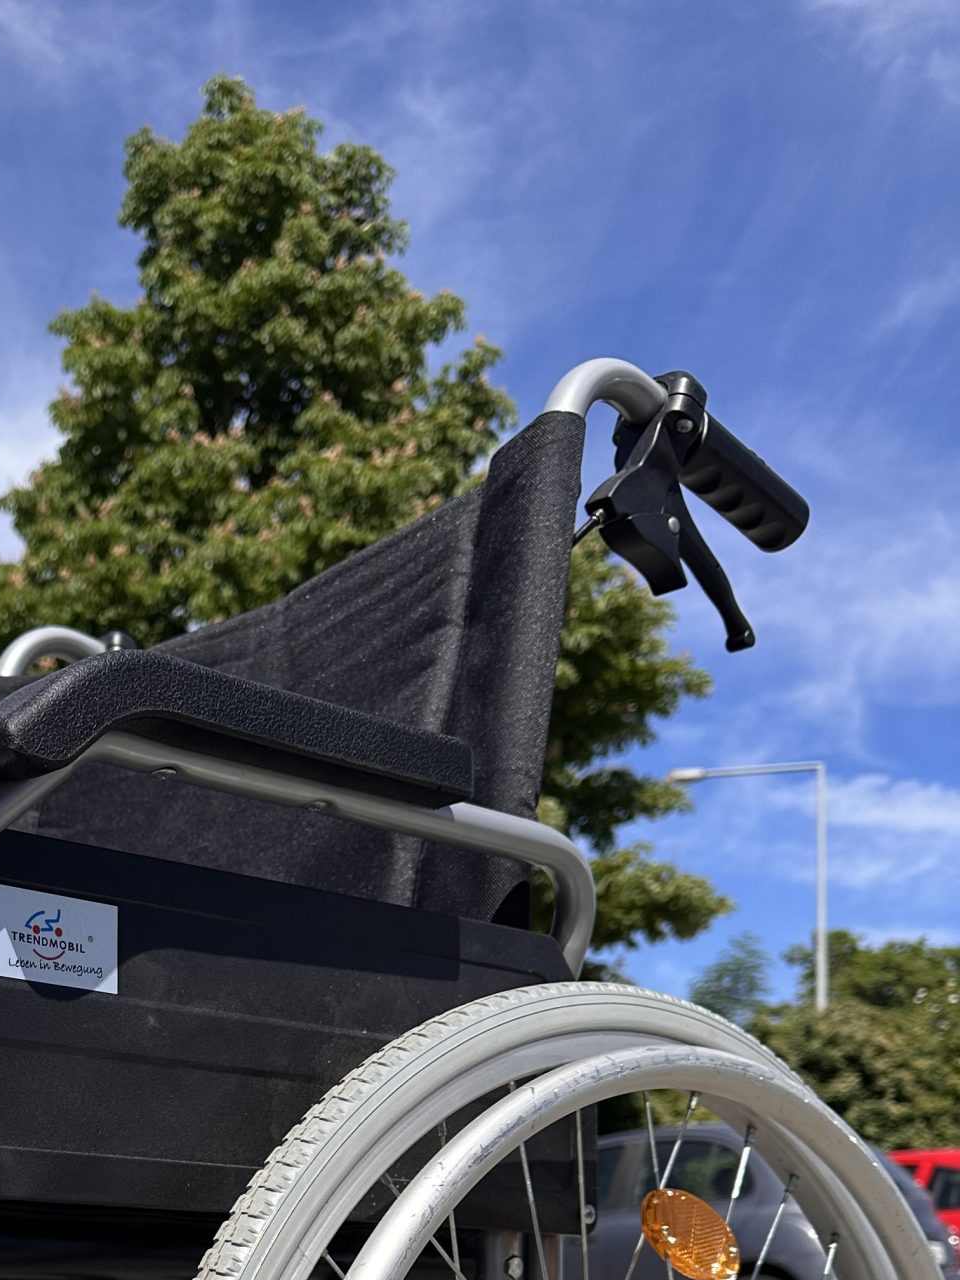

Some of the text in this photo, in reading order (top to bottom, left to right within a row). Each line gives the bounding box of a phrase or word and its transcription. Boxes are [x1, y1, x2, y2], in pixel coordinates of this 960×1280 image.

[11, 931, 86, 953] TRENDMOBIL
[8, 957, 104, 978] Leben in Bewegung
